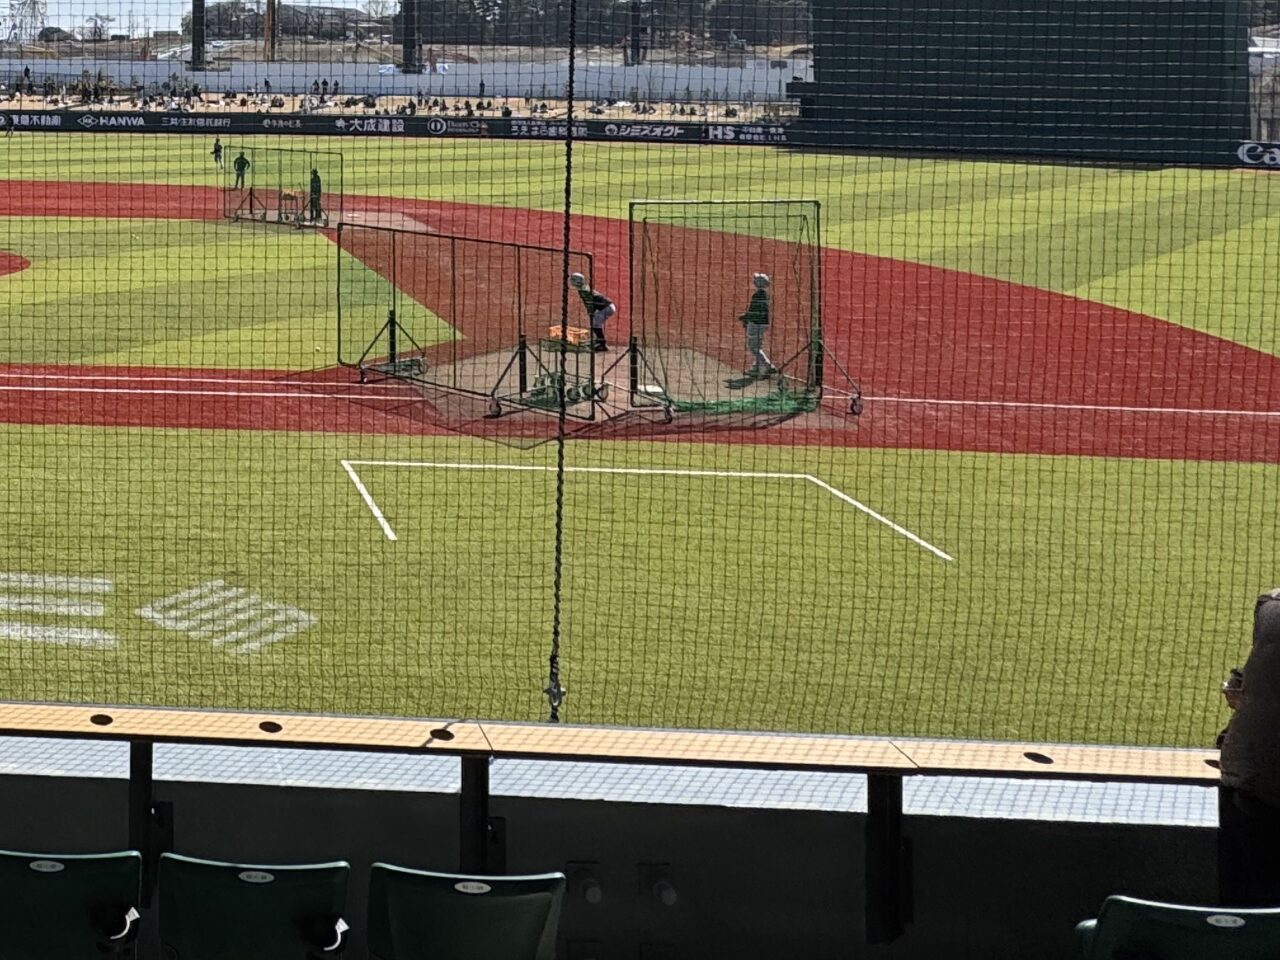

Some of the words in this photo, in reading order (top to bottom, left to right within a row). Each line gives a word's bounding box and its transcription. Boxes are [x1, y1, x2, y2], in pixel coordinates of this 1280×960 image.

[99, 116, 145, 127] HANWA
[349, 118, 405, 133] 大成建設
[620, 125, 685, 137] シミズオクト
